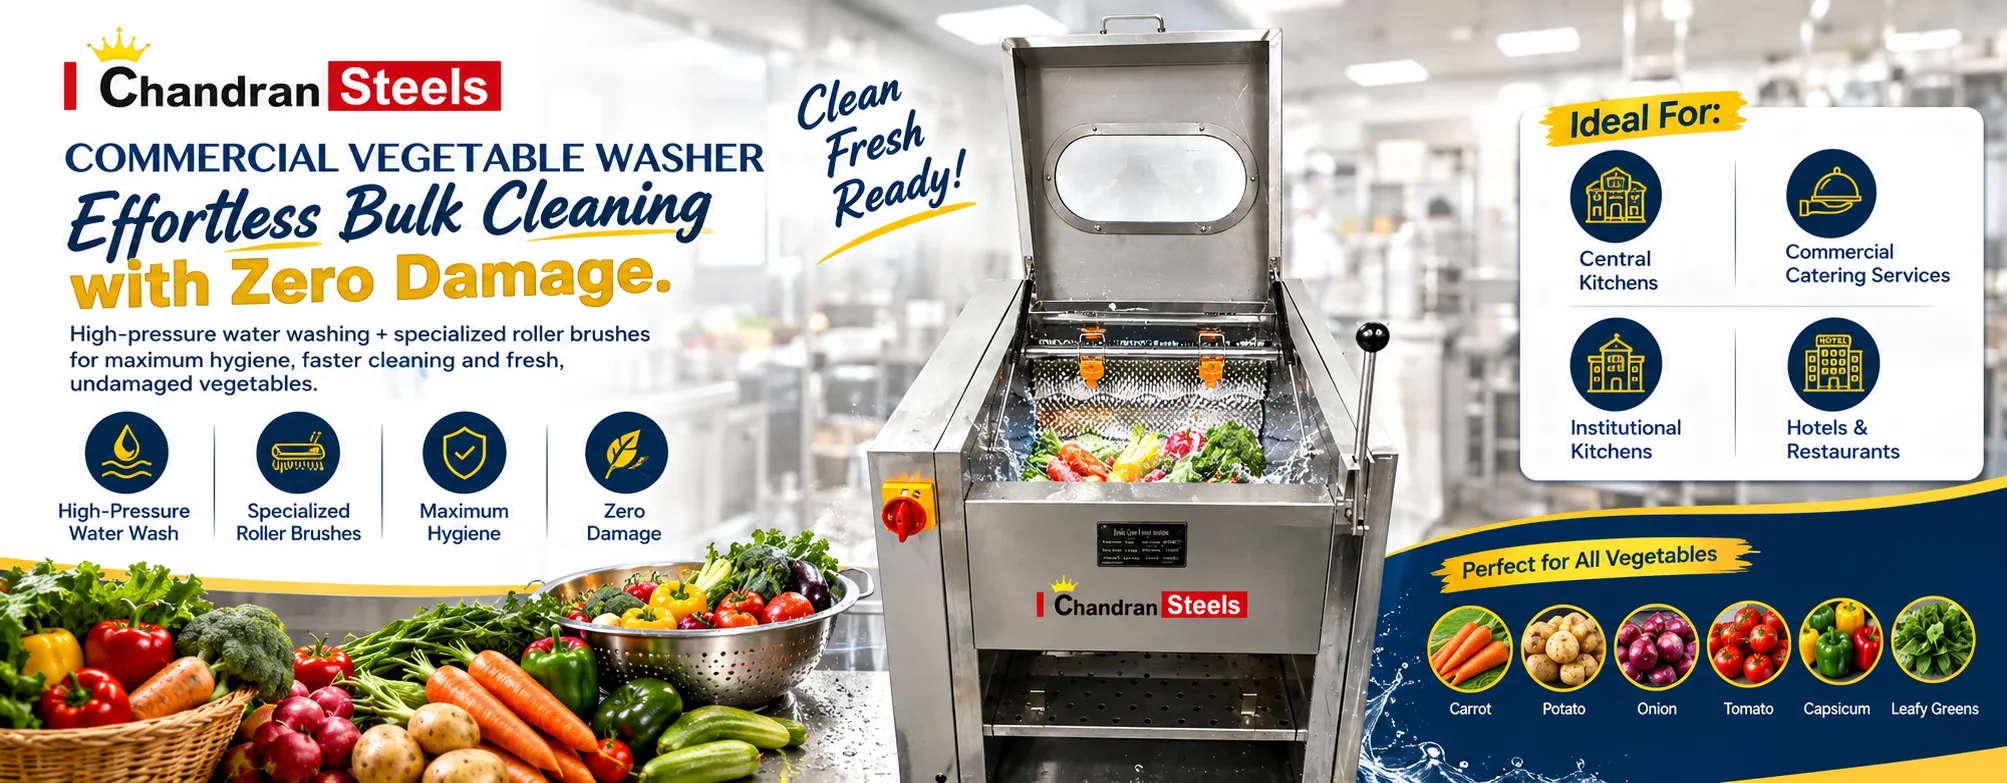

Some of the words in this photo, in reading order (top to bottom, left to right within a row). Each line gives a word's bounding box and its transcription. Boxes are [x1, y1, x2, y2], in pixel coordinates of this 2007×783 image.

[99, 65, 320, 108] Chandran
[340, 66, 488, 106] Steels
[797, 79, 903, 131] Clean
[1570, 103, 1649, 139] Ideal
[1659, 100, 1721, 129] For:
[826, 109, 925, 178] Fresh
[65, 142, 340, 173] COMMERCIAL
[348, 142, 585, 173] VEGETABLE
[595, 142, 765, 173] WASHER
[833, 148, 966, 228] Ready!
[66, 189, 320, 264] Effortless
[338, 181, 464, 244] Bulk
[482, 178, 713, 244] Cleaning
[1579, 250, 1651, 267] Central
[1785, 243, 1894, 260] Commercial
[69, 257, 209, 310] with
[231, 257, 375, 306] Zero
[396, 253, 671, 308] Damage.
[1580, 274, 1659, 291] Kitchens
[1785, 266, 1866, 287] Catering
[1871, 266, 1951, 283] Services
[70, 325, 217, 347] High-pressure
[222, 326, 281, 342] water
[286, 325, 370, 347] washing
[376, 328, 388, 340] +
[394, 324, 506, 347] specialized
[513, 324, 565, 342] roller
[570, 325, 651, 342] brushes
[69, 351, 99, 368] for
[105, 351, 203, 368] maximum
[210, 351, 295, 372] hygiene,
[301, 351, 363, 368] faster
[368, 351, 455, 373] cleaning
[462, 351, 500, 368] and
[506, 351, 564, 371] fresh,
[70, 374, 193, 396] undamaged
[199, 374, 318, 396] vegetables.
[1571, 418, 1681, 436] Institutional
[1787, 418, 1848, 436] Hotels
[1853, 419, 1868, 436] &
[1571, 443, 1653, 459] Kitchens
[1787, 443, 1900, 459] Restaurants
[59, 502, 190, 523] High-Pressure
[248, 502, 350, 523] Specialized
[420, 502, 509, 519] Maximum
[604, 503, 646, 519] Zero
[68, 525, 124, 541] Water
[128, 525, 179, 541] Wash
[237, 525, 287, 541] Roller
[291, 525, 362, 541] Brushes
[428, 525, 501, 545] Hygiene
[587, 525, 662, 545] Damage
[1462, 556, 1536, 580] Perfect
[1540, 553, 1570, 572] for
[1574, 550, 1600, 569] All
[1605, 545, 1718, 570] Vegetables
[1054, 593, 1158, 616] Chandran
[1167, 594, 1241, 615] Steels
[1449, 701, 1492, 716] Carrot
[1543, 702, 1586, 716] Potato
[1637, 701, 1677, 715] Onion
[1723, 701, 1774, 716] Tomato
[1803, 701, 1871, 719] Capsicum
[1891, 701, 1928, 719] Leafy
[1931, 701, 1980, 716] Greens
